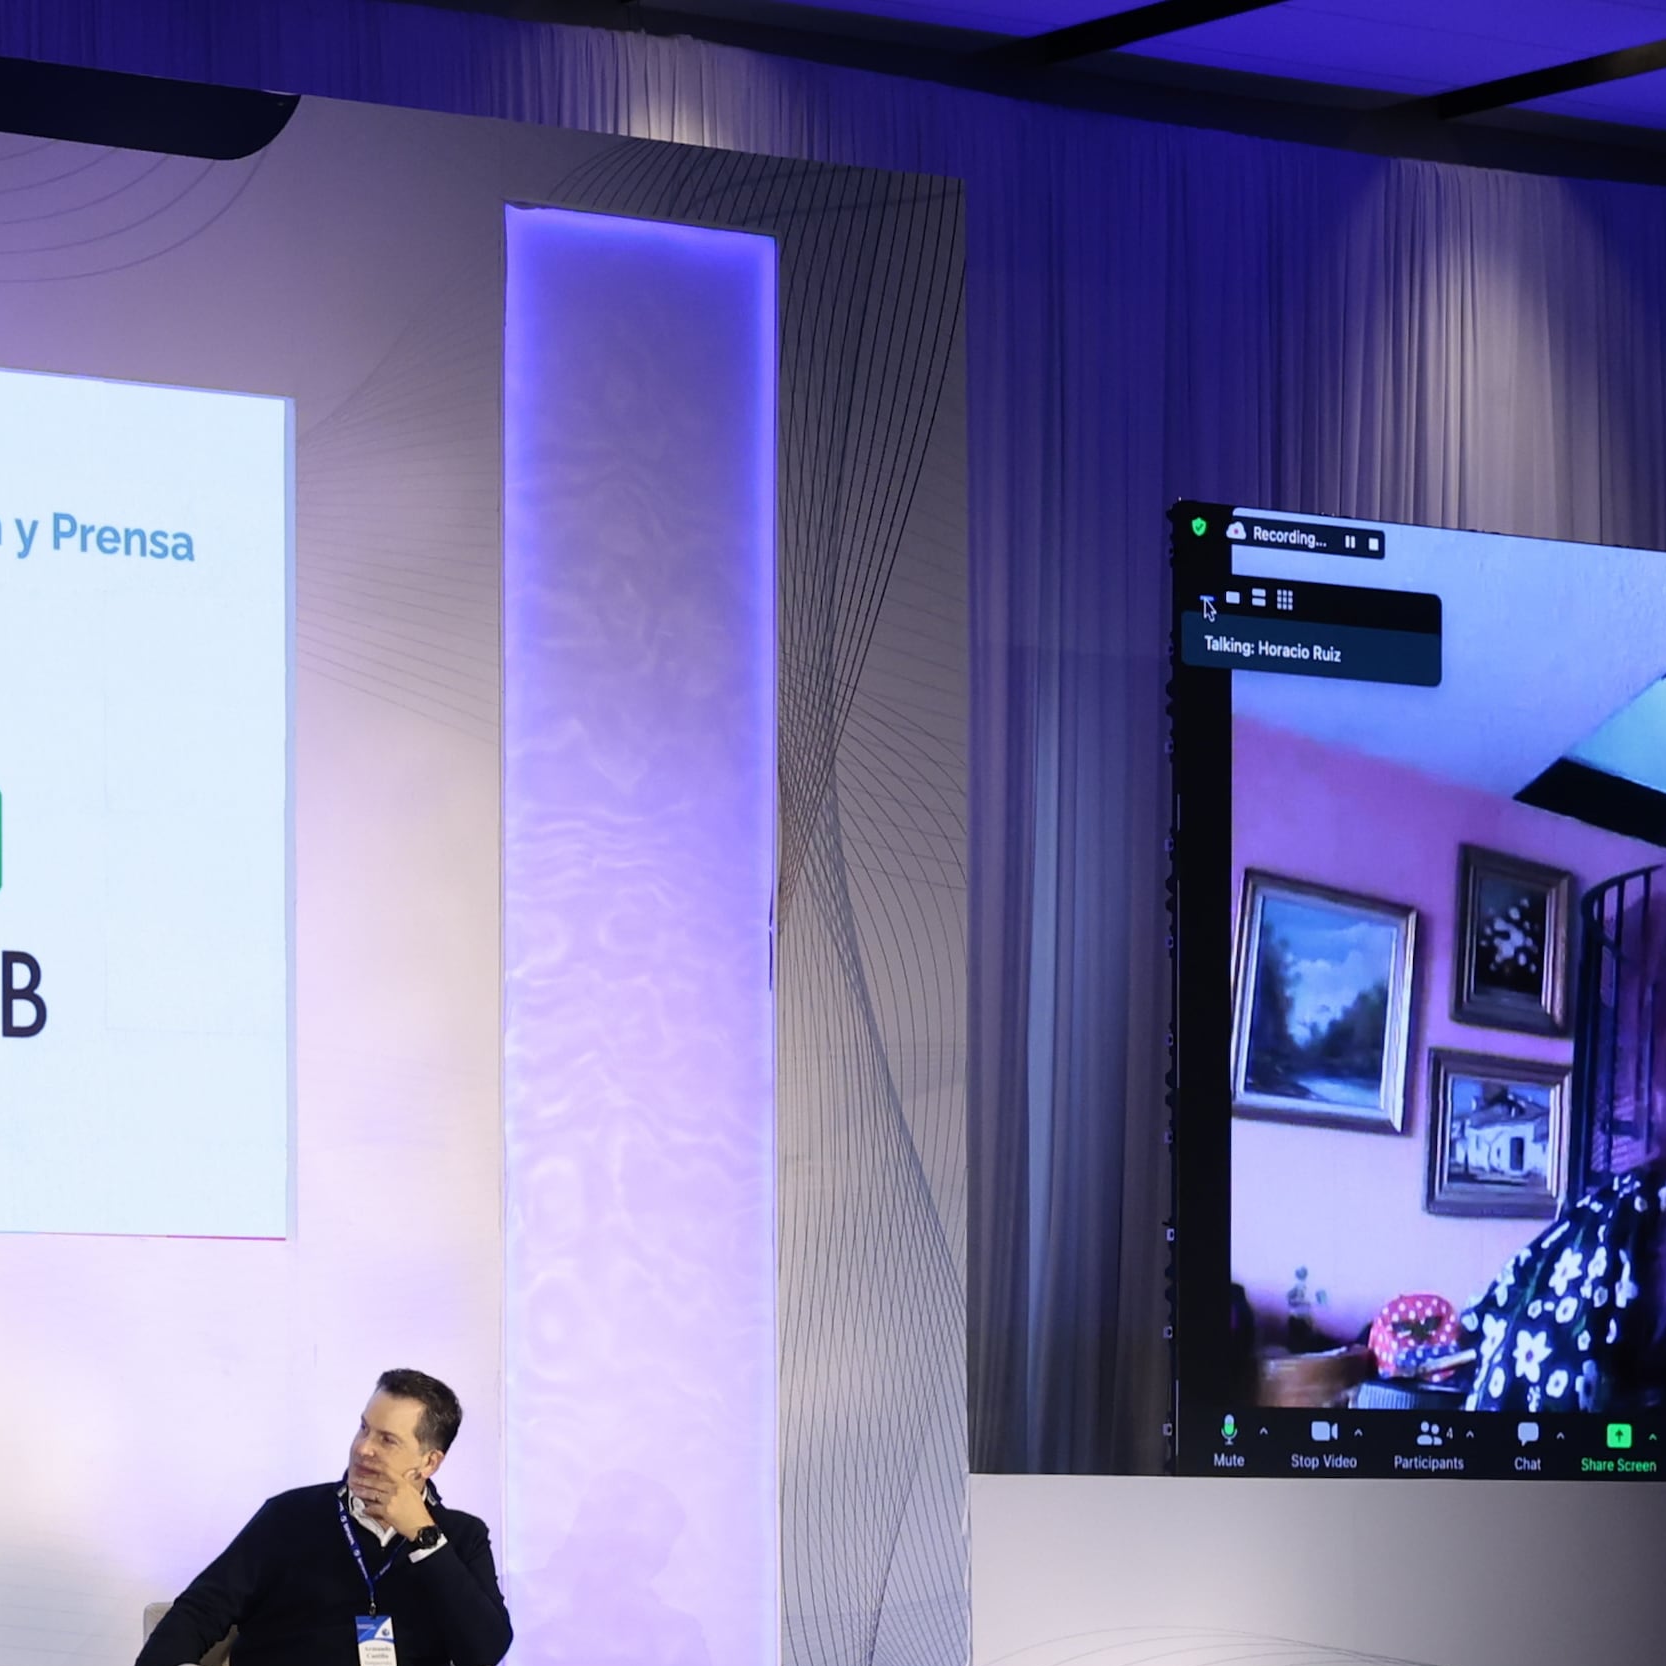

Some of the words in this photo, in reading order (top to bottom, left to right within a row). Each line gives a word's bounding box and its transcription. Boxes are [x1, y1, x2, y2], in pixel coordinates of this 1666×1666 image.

[14, 517, 39, 559] y
[52, 512, 195, 562] Prensa
[1253, 525, 1327, 549] Recording...
[1204, 635, 1255, 656] Talking:
[1258, 640, 1310, 660] Horacio
[1313, 645, 1342, 663] Ruiz
[1213, 1453, 1245, 1468] Mute
[1291, 1454, 1320, 1471] Stop
[1323, 1454, 1358, 1469] Video
[1393, 1455, 1465, 1472] Participants
[1514, 1456, 1541, 1471] Chat
[1581, 1458, 1614, 1472] Share
[1617, 1458, 1657, 1473] Screen
